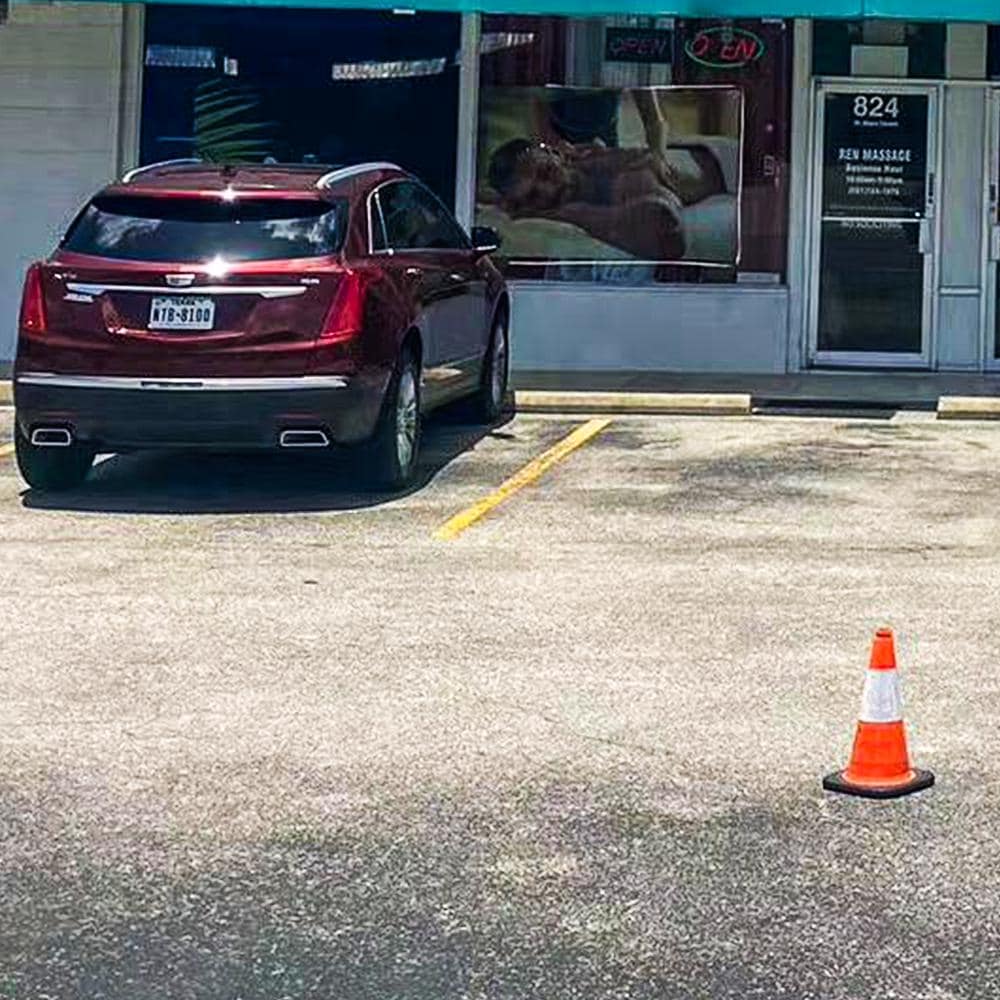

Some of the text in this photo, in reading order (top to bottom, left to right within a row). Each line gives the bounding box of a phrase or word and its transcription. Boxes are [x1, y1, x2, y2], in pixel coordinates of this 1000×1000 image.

[853, 95, 899, 118] 824
[839, 148, 911, 162] REN MASSAGE
